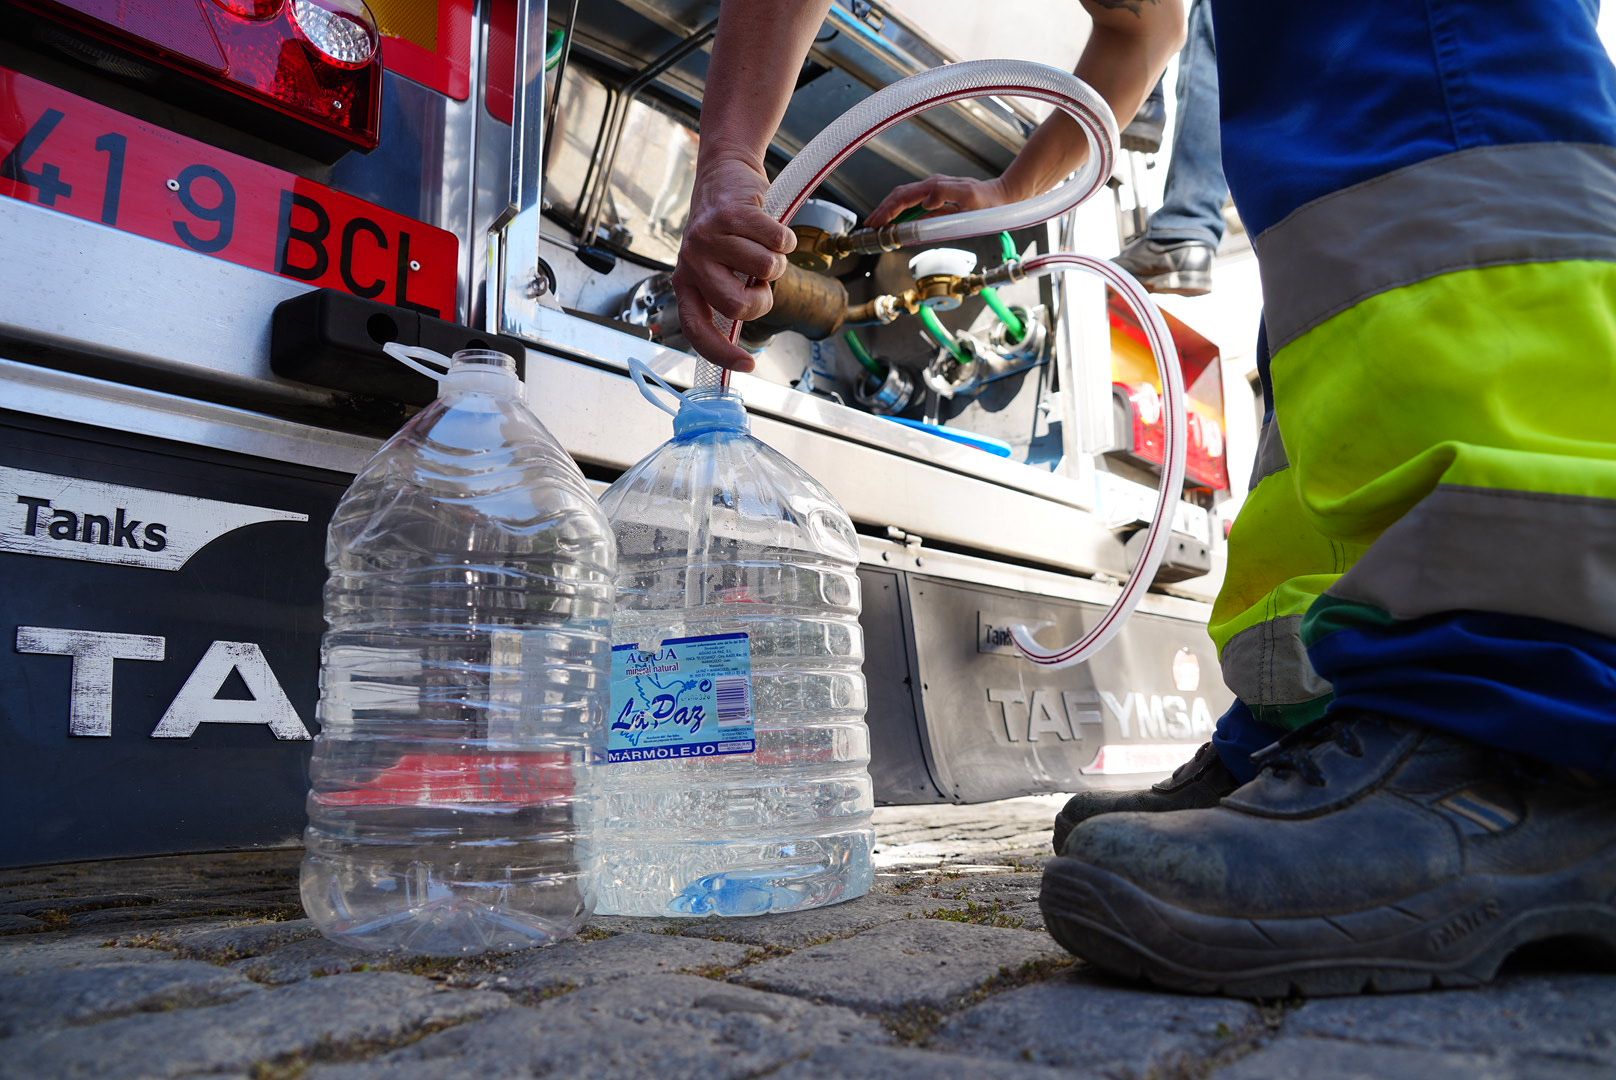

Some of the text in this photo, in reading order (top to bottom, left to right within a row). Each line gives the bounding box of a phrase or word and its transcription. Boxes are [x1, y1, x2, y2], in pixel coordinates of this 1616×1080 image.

[2, 108, 440, 319] 419 BCL
[17, 495, 168, 552] Tanks
[653, 662, 680, 673] natural
[608, 745, 716, 762] MARMOLEJO
